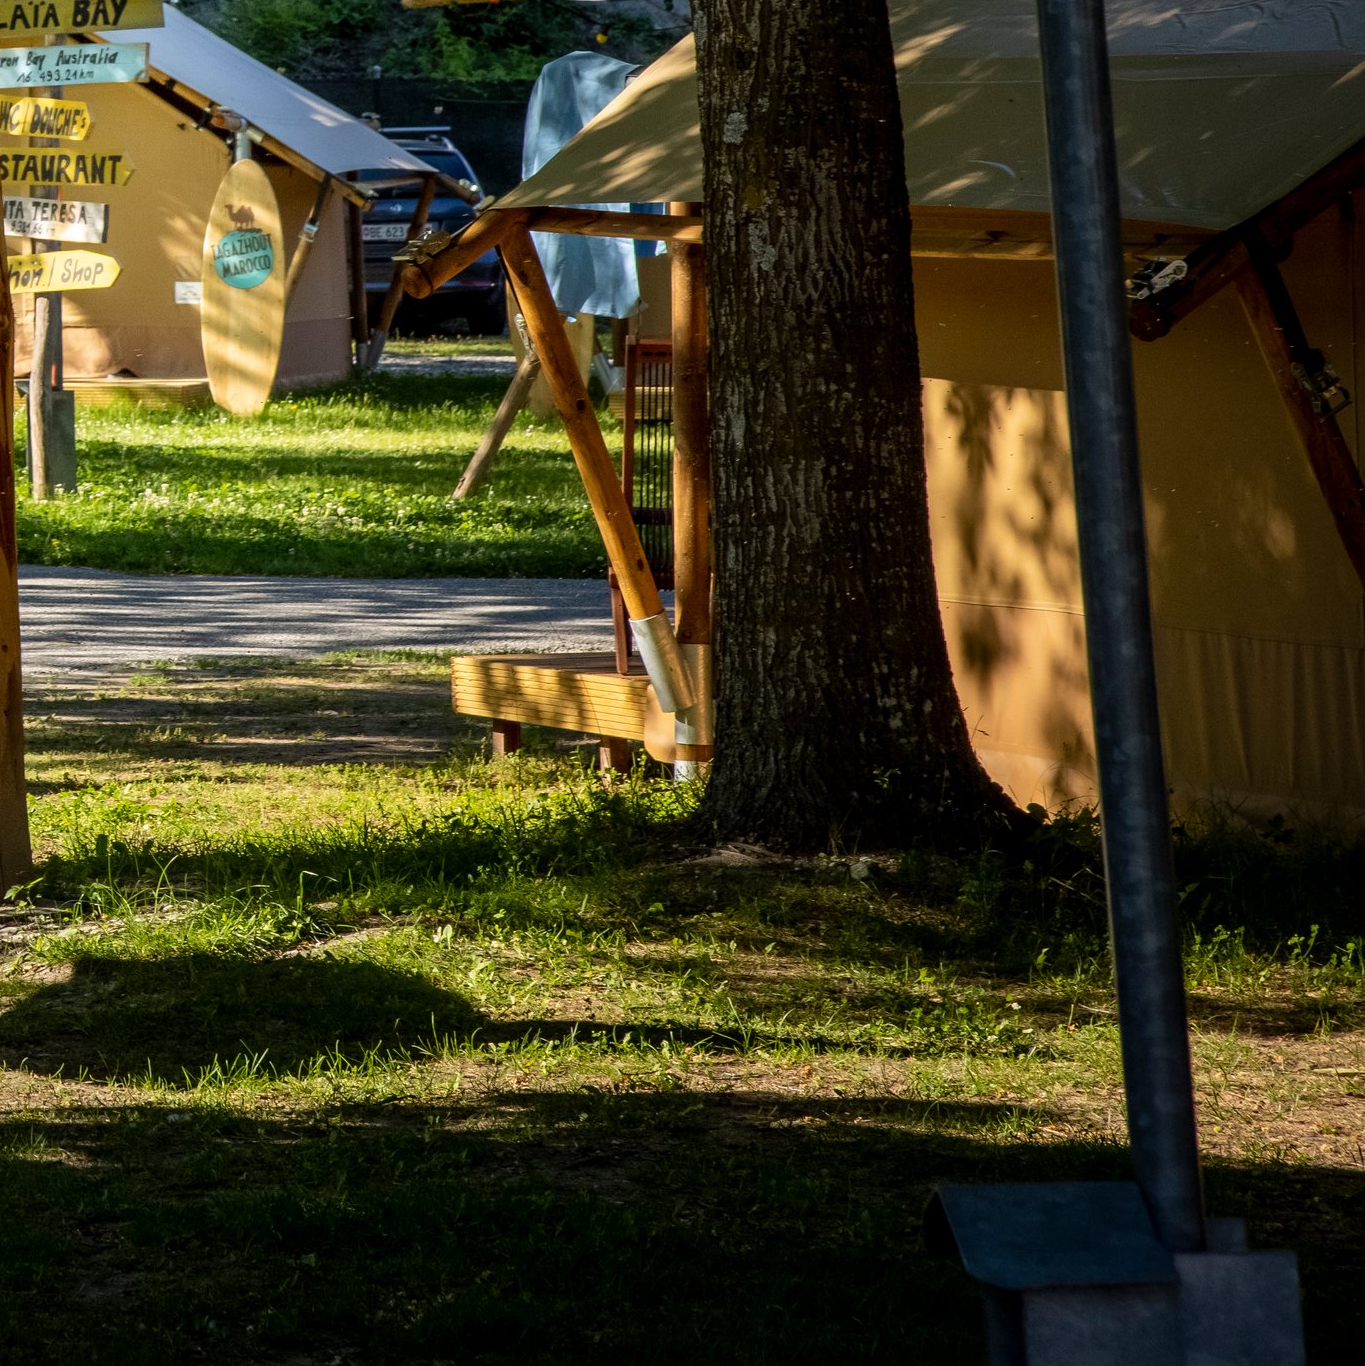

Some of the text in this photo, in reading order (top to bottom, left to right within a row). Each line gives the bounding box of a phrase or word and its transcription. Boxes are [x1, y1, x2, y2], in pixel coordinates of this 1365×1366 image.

[25, 50, 46, 70] Bay
[55, 46, 119, 67] Australia
[32, 200, 88, 225] TERESA
